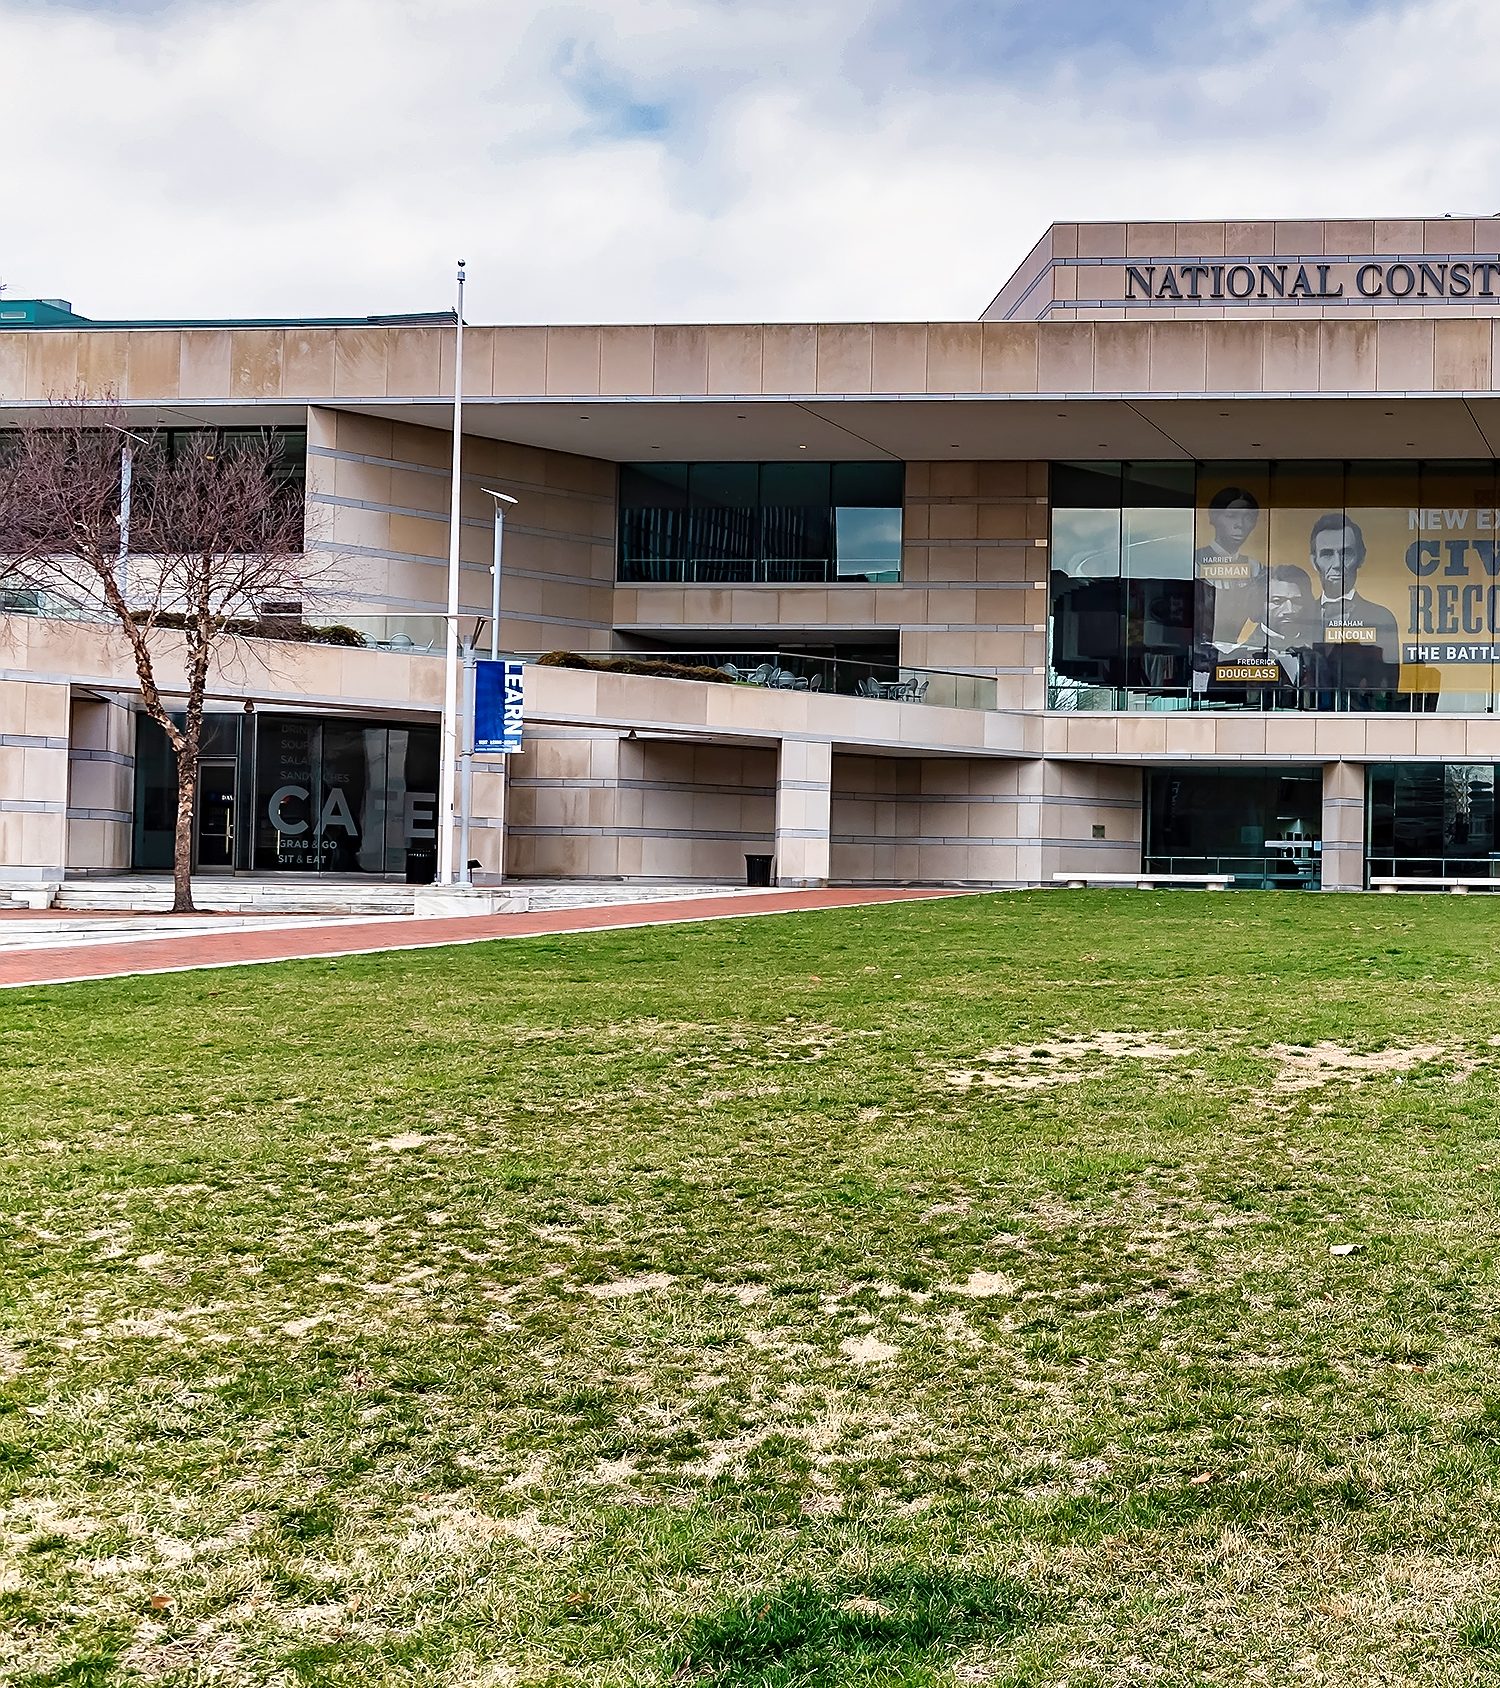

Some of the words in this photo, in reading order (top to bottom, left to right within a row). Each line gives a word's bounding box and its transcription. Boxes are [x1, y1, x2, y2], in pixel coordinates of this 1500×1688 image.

[1125, 264, 1344, 299] NATIONAL
[1408, 509, 1469, 530] NEW
[1203, 566, 1249, 576] TUBMAN
[1328, 630, 1374, 640] LINCOLN
[1407, 646, 1440, 660] THE
[1237, 658, 1277, 666] FREDERICK
[1218, 668, 1276, 679] DOUGLASS
[504, 661, 524, 735] LEARN
[280, 839, 309, 848] GRAB
[322, 841, 337, 849] GO
[278, 854, 294, 863] SIT
[306, 855, 327, 864] EAT
